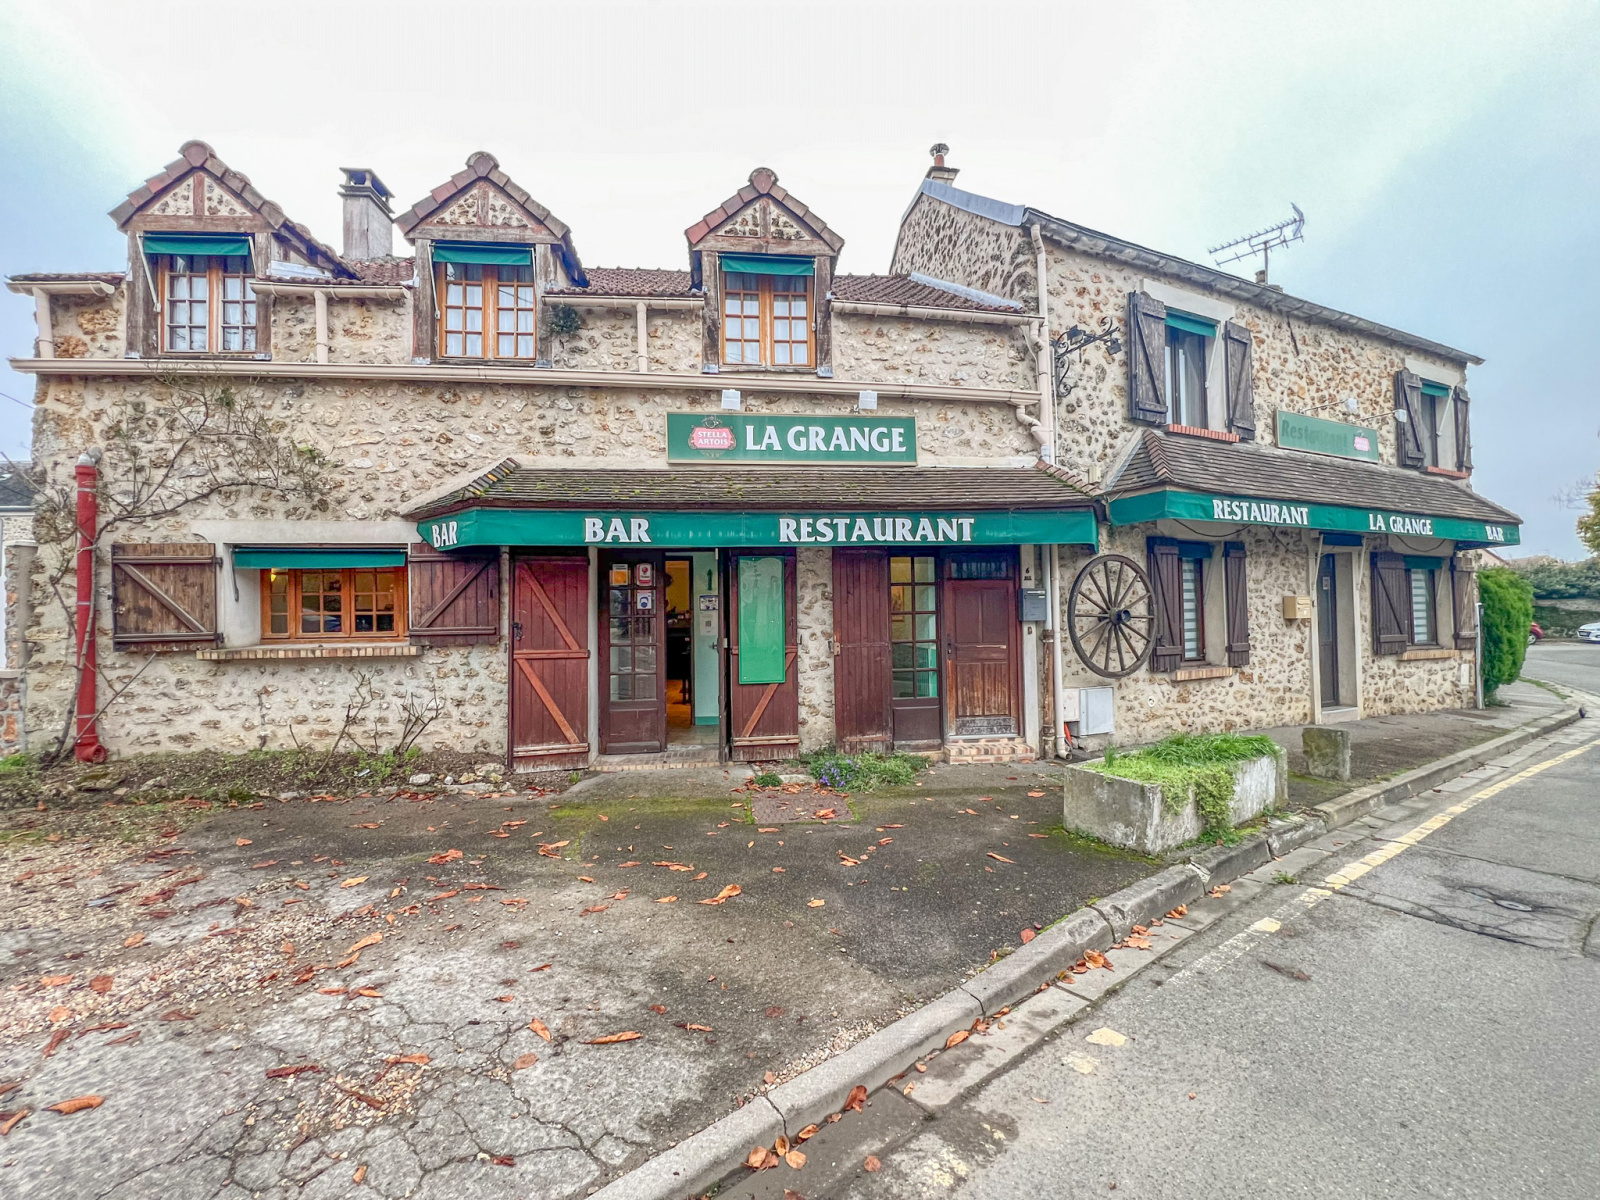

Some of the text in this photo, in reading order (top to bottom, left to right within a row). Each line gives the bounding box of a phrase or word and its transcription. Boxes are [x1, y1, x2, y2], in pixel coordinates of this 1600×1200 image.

[698, 438, 729, 446] ARTOIS
[745, 425, 907, 453] LA GRANGE
[1212, 500, 1309, 526] RESTAURANT
[1368, 513, 1433, 536] LA GRANGE
[431, 521, 458, 548] BAR
[584, 518, 652, 543] BAR
[778, 518, 975, 543] RESTAURANT
[1486, 526, 1505, 542] BAR
